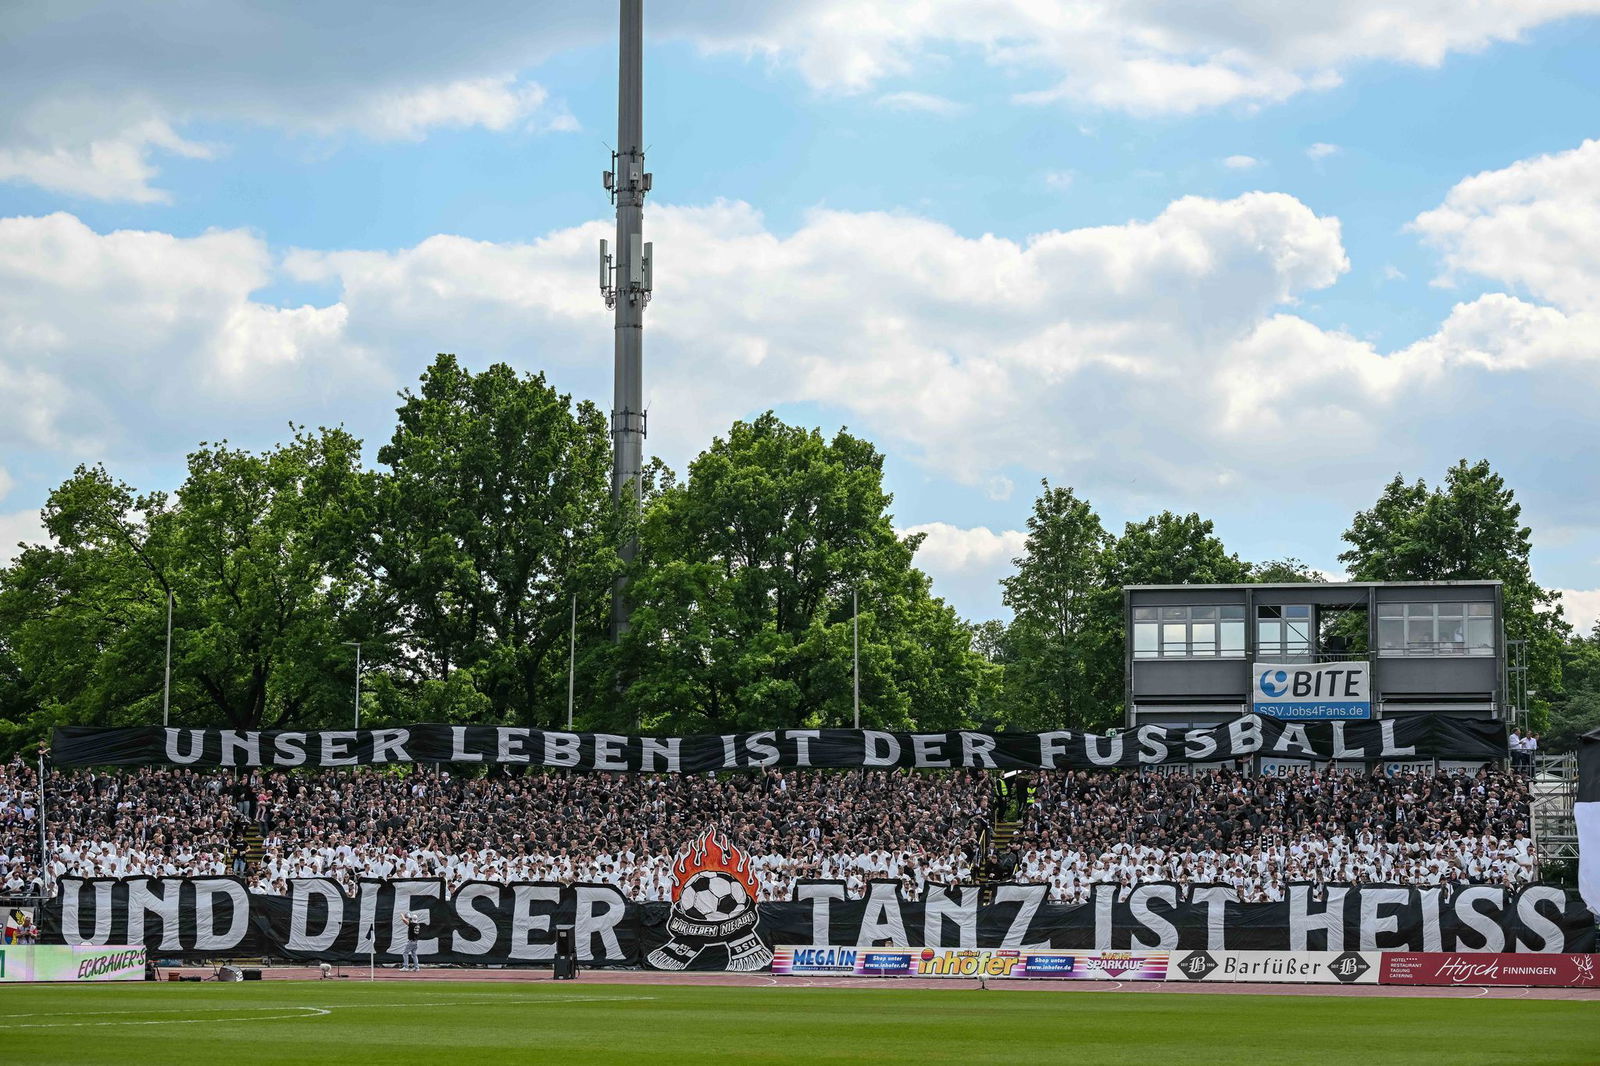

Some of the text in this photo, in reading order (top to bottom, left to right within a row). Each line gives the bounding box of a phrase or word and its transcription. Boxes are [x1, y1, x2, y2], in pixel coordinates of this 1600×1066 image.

[1292, 670, 1363, 697] BITE
[1259, 705, 1364, 717] SSV.Jobs4Fans.de
[164, 713, 1416, 773] UNSER LEBEN IST DER FUSSBALL
[61, 877, 1567, 961] UND DIESER TANZ IST HEISS
[734, 939, 757, 954] BSU
[77, 947, 146, 979] ECKBAUER'S
[918, 948, 1020, 976] inhofer
[1087, 960, 1145, 971] SPARKAUF
[1224, 957, 1322, 975] Barfüßer
[1435, 957, 1499, 982] Hirsch
[1503, 966, 1557, 975] FINNINGEN
